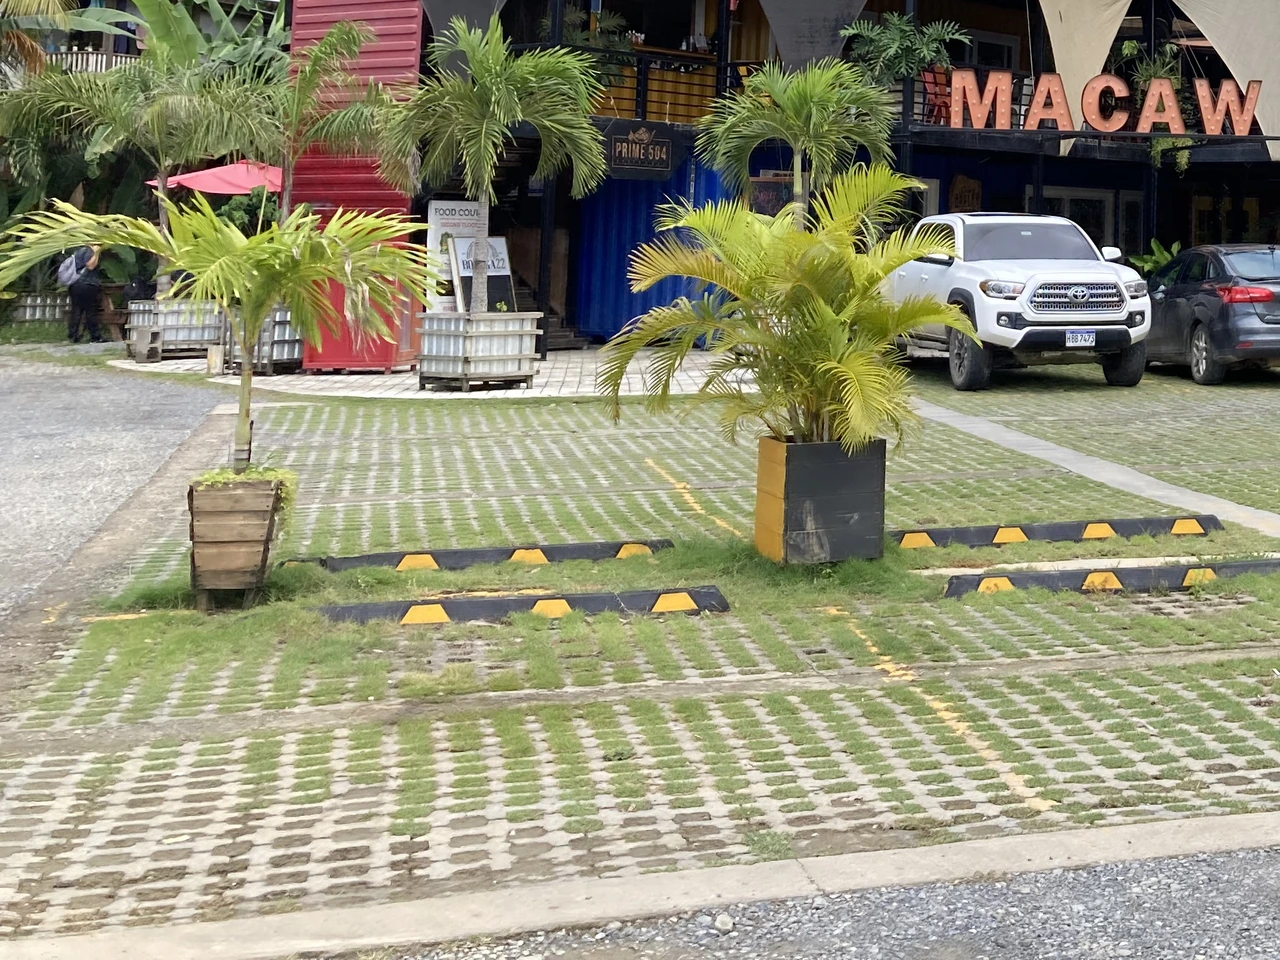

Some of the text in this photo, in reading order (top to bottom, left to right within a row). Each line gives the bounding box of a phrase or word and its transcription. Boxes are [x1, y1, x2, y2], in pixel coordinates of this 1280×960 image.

[951, 68, 1263, 137] MACAW
[616, 142, 667, 161] PRIME 504
[434, 207, 479, 217] FOOD COU
[462, 258, 506, 270] BOA22
